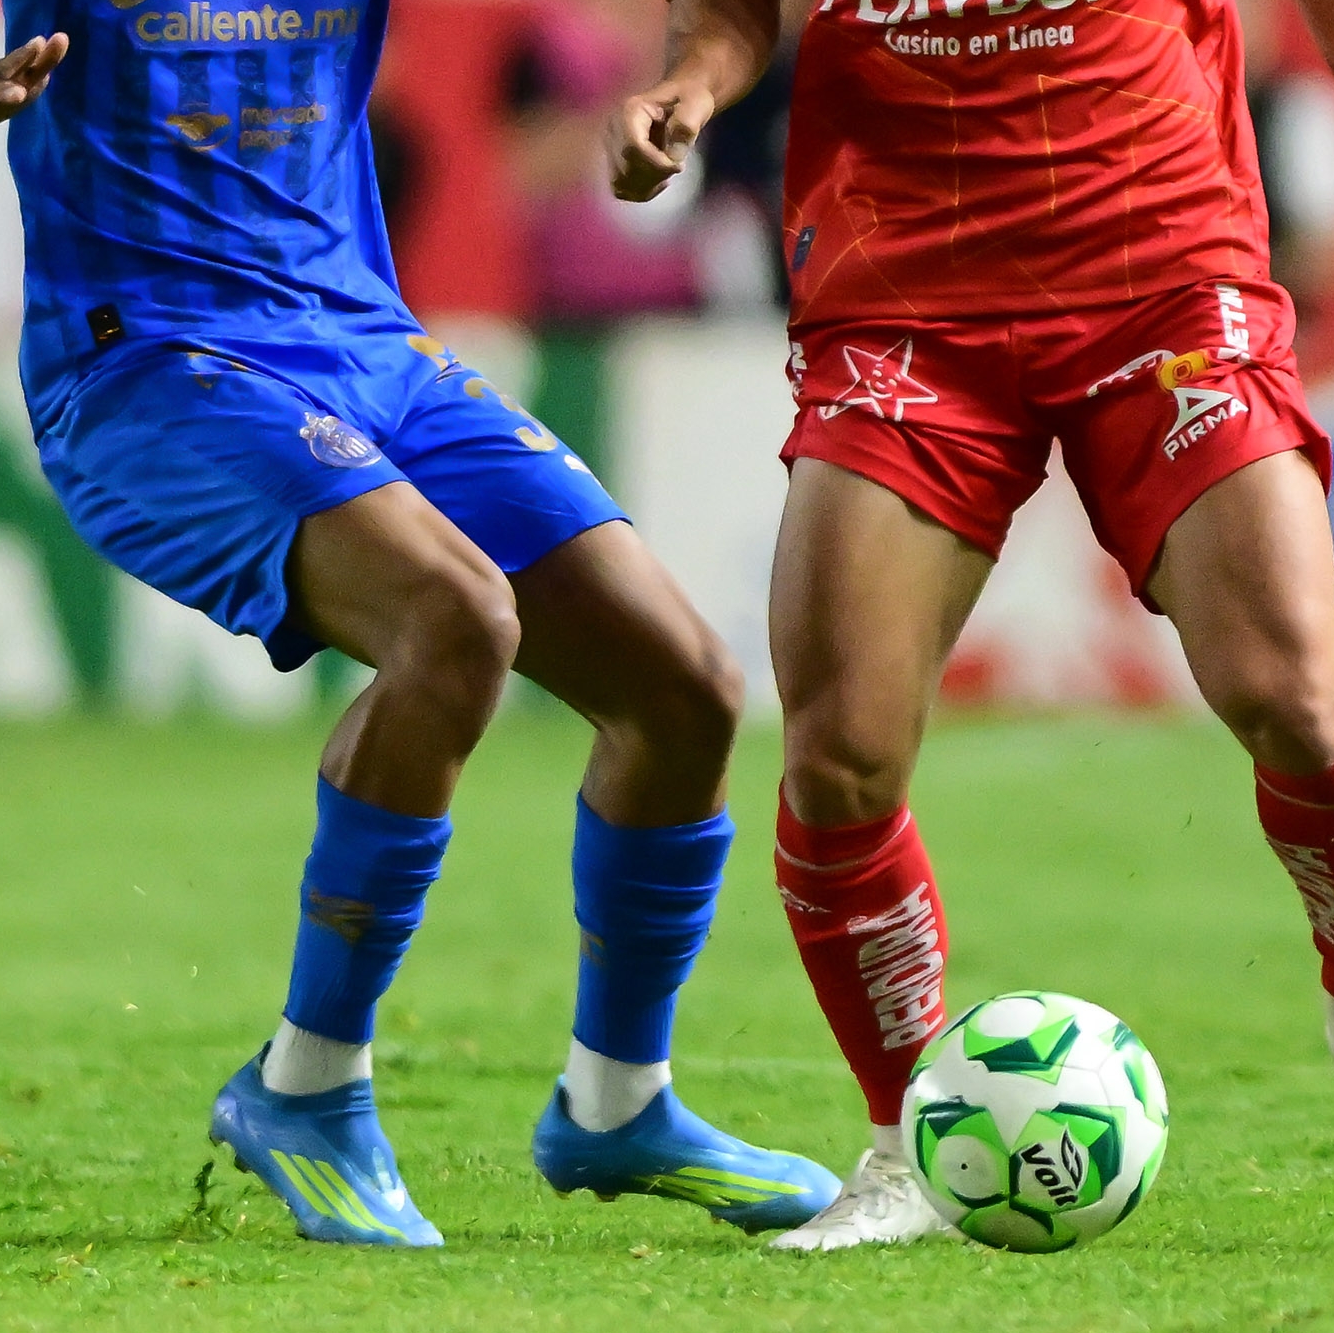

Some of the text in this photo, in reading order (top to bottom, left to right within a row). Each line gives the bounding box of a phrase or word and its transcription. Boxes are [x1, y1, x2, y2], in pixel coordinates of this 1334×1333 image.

[884, 23, 1075, 57] Casino en Línea
[1163, 398, 1249, 461] PIRMA
